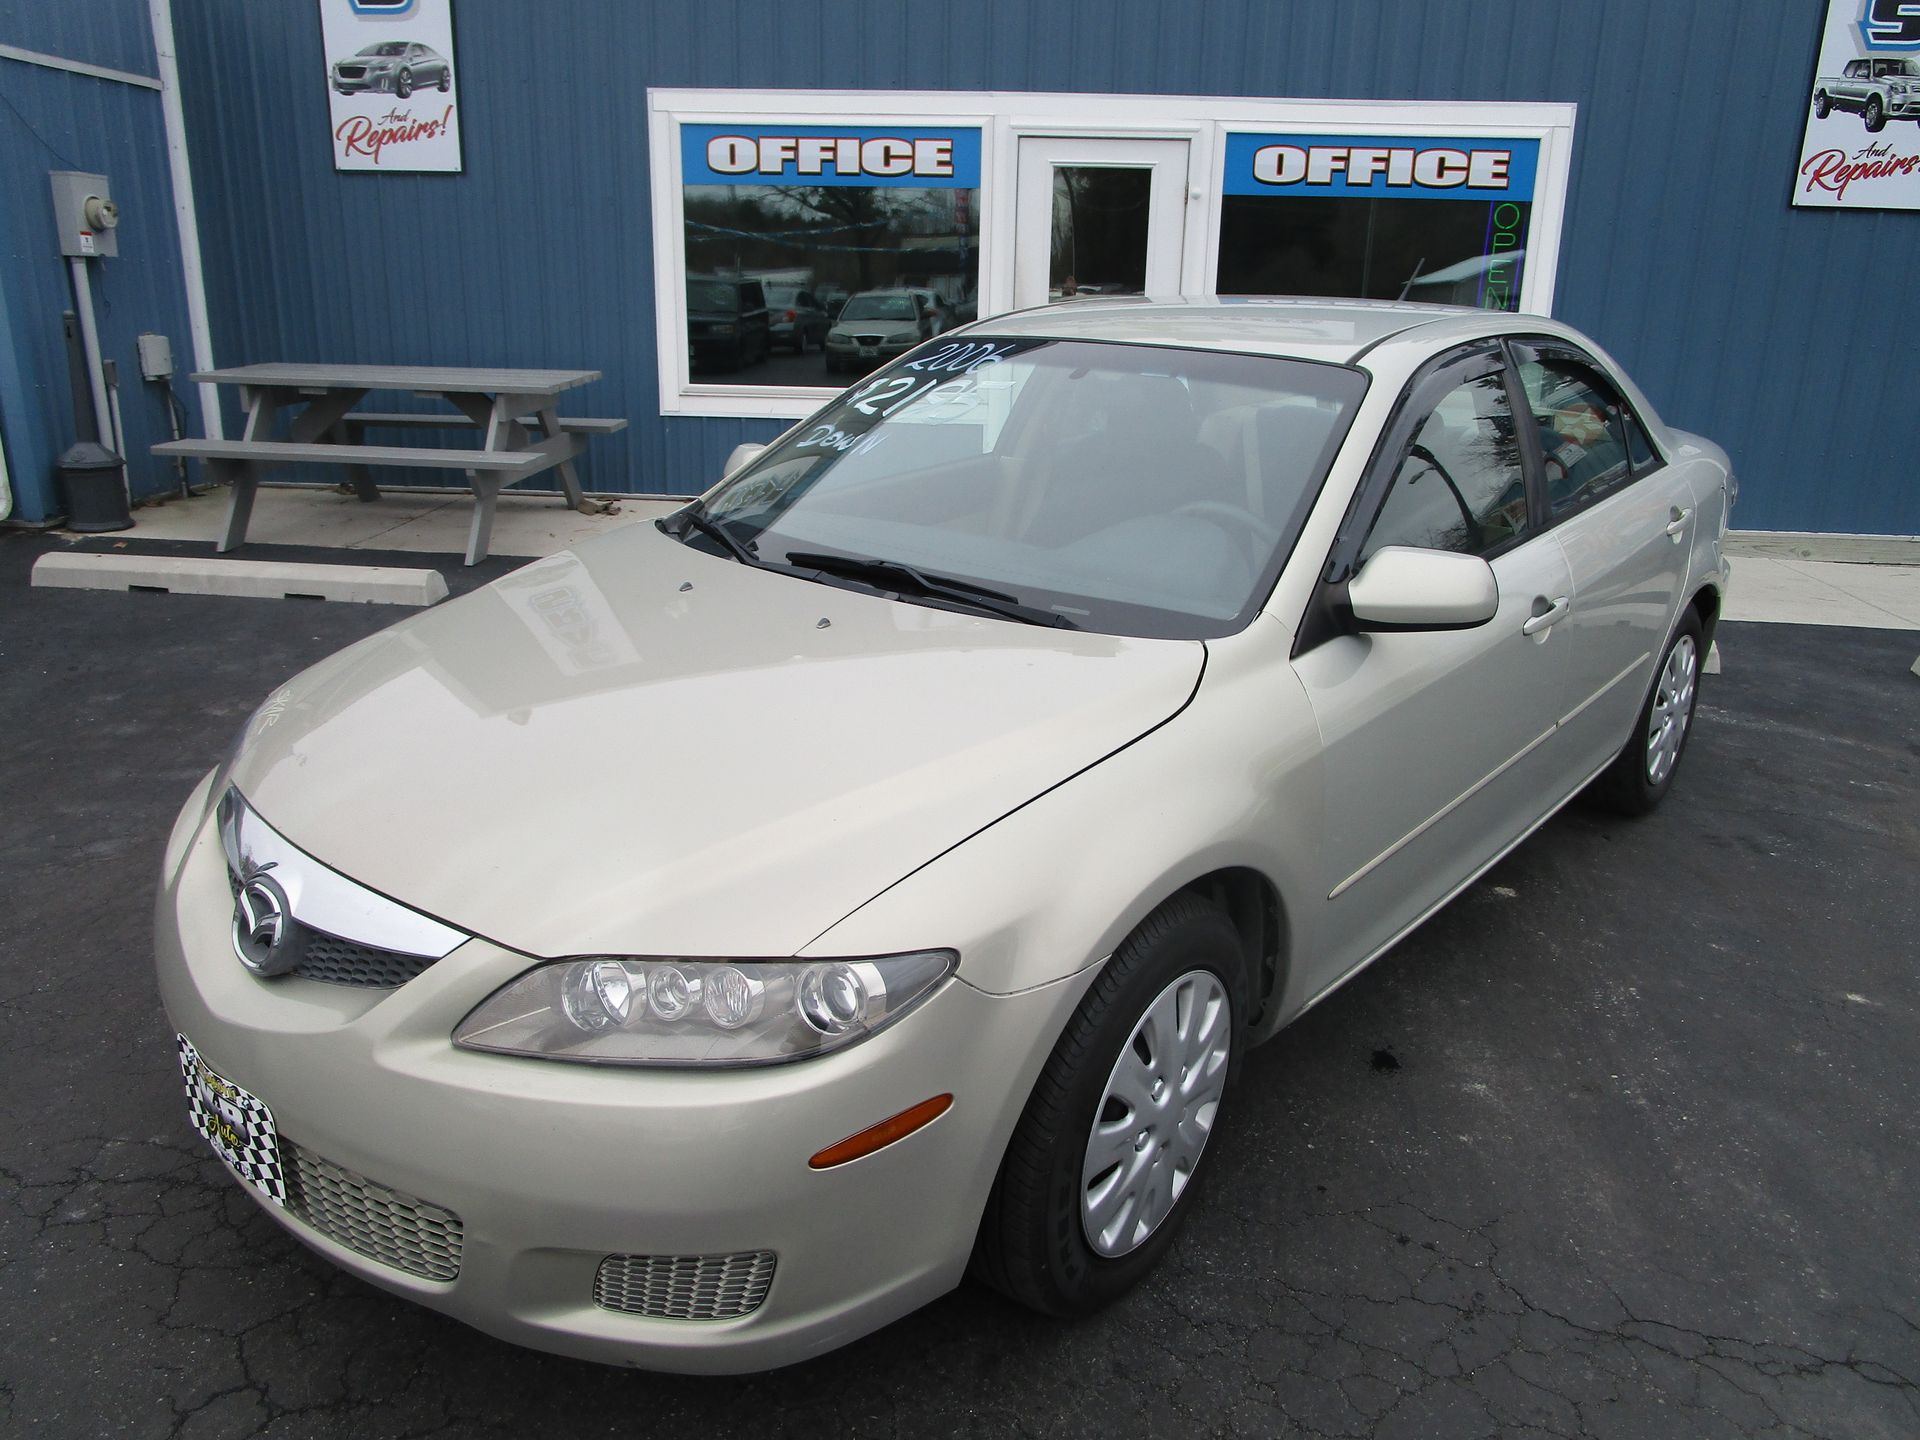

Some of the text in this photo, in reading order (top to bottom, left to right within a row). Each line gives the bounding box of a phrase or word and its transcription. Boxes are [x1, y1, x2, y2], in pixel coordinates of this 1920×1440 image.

[335, 104, 454, 165] Repairs!
[377, 107, 412, 126] And
[707, 135, 954, 178] OFFICE
[1253, 144, 1511, 190] OFFICE
[1852, 141, 1893, 160] And
[1801, 149, 1920, 201] Repairs
[1484, 203, 1520, 310] OPEN
[903, 343, 1016, 374] 2006
